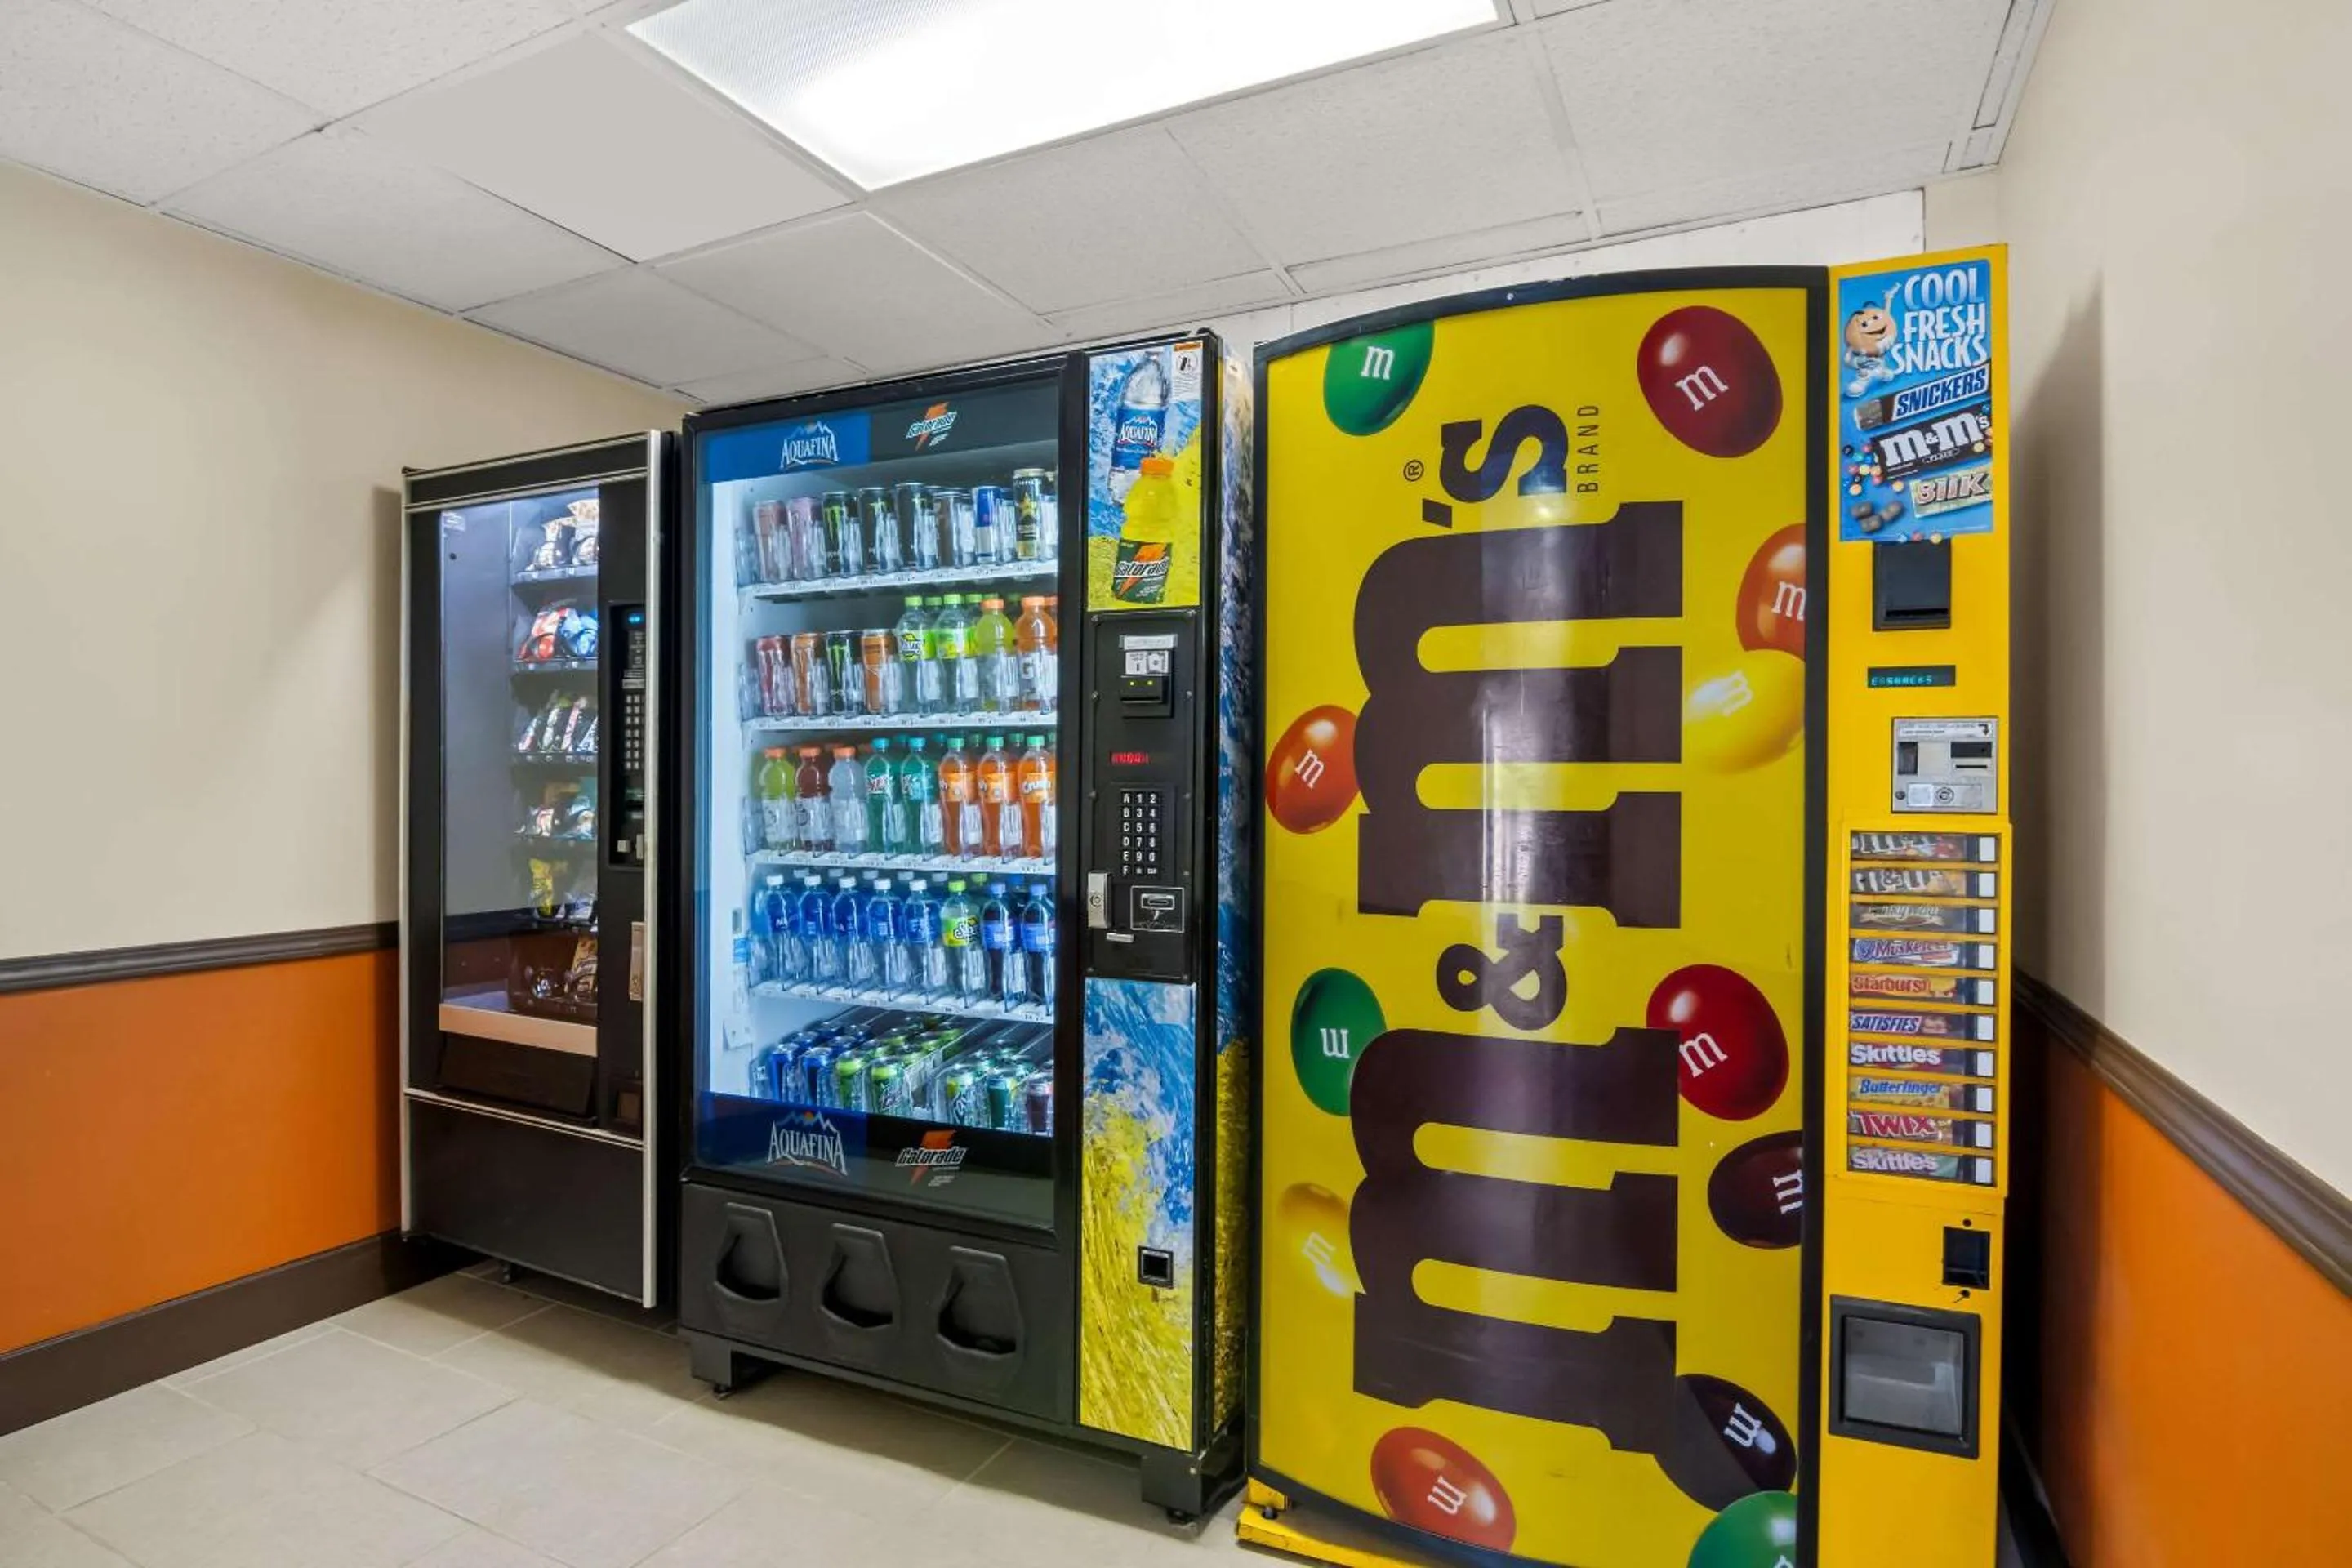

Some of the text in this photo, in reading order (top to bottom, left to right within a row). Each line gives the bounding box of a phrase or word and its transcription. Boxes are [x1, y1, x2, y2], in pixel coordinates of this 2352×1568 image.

[1904, 267, 1984, 310] COOL
[1903, 303, 1987, 344] FRESH
[1890, 335, 1989, 376] SNACKS
[1896, 375, 1987, 417] SNICKERS
[780, 433, 840, 470] AQUAFINA
[1576, 405, 1599, 494] BRAND
[1852, 974, 1931, 993] Starburst
[1851, 1015, 1918, 1032] SATISFIES
[1851, 1043, 1941, 1065] Skittles
[1860, 1078, 1941, 1094] Butterfinger
[1852, 1111, 1936, 1137] TWIX
[767, 1120, 849, 1176] AQUAFINA
[895, 1146, 968, 1167] Gatorade
[1851, 1152, 1939, 1171] Skittles
